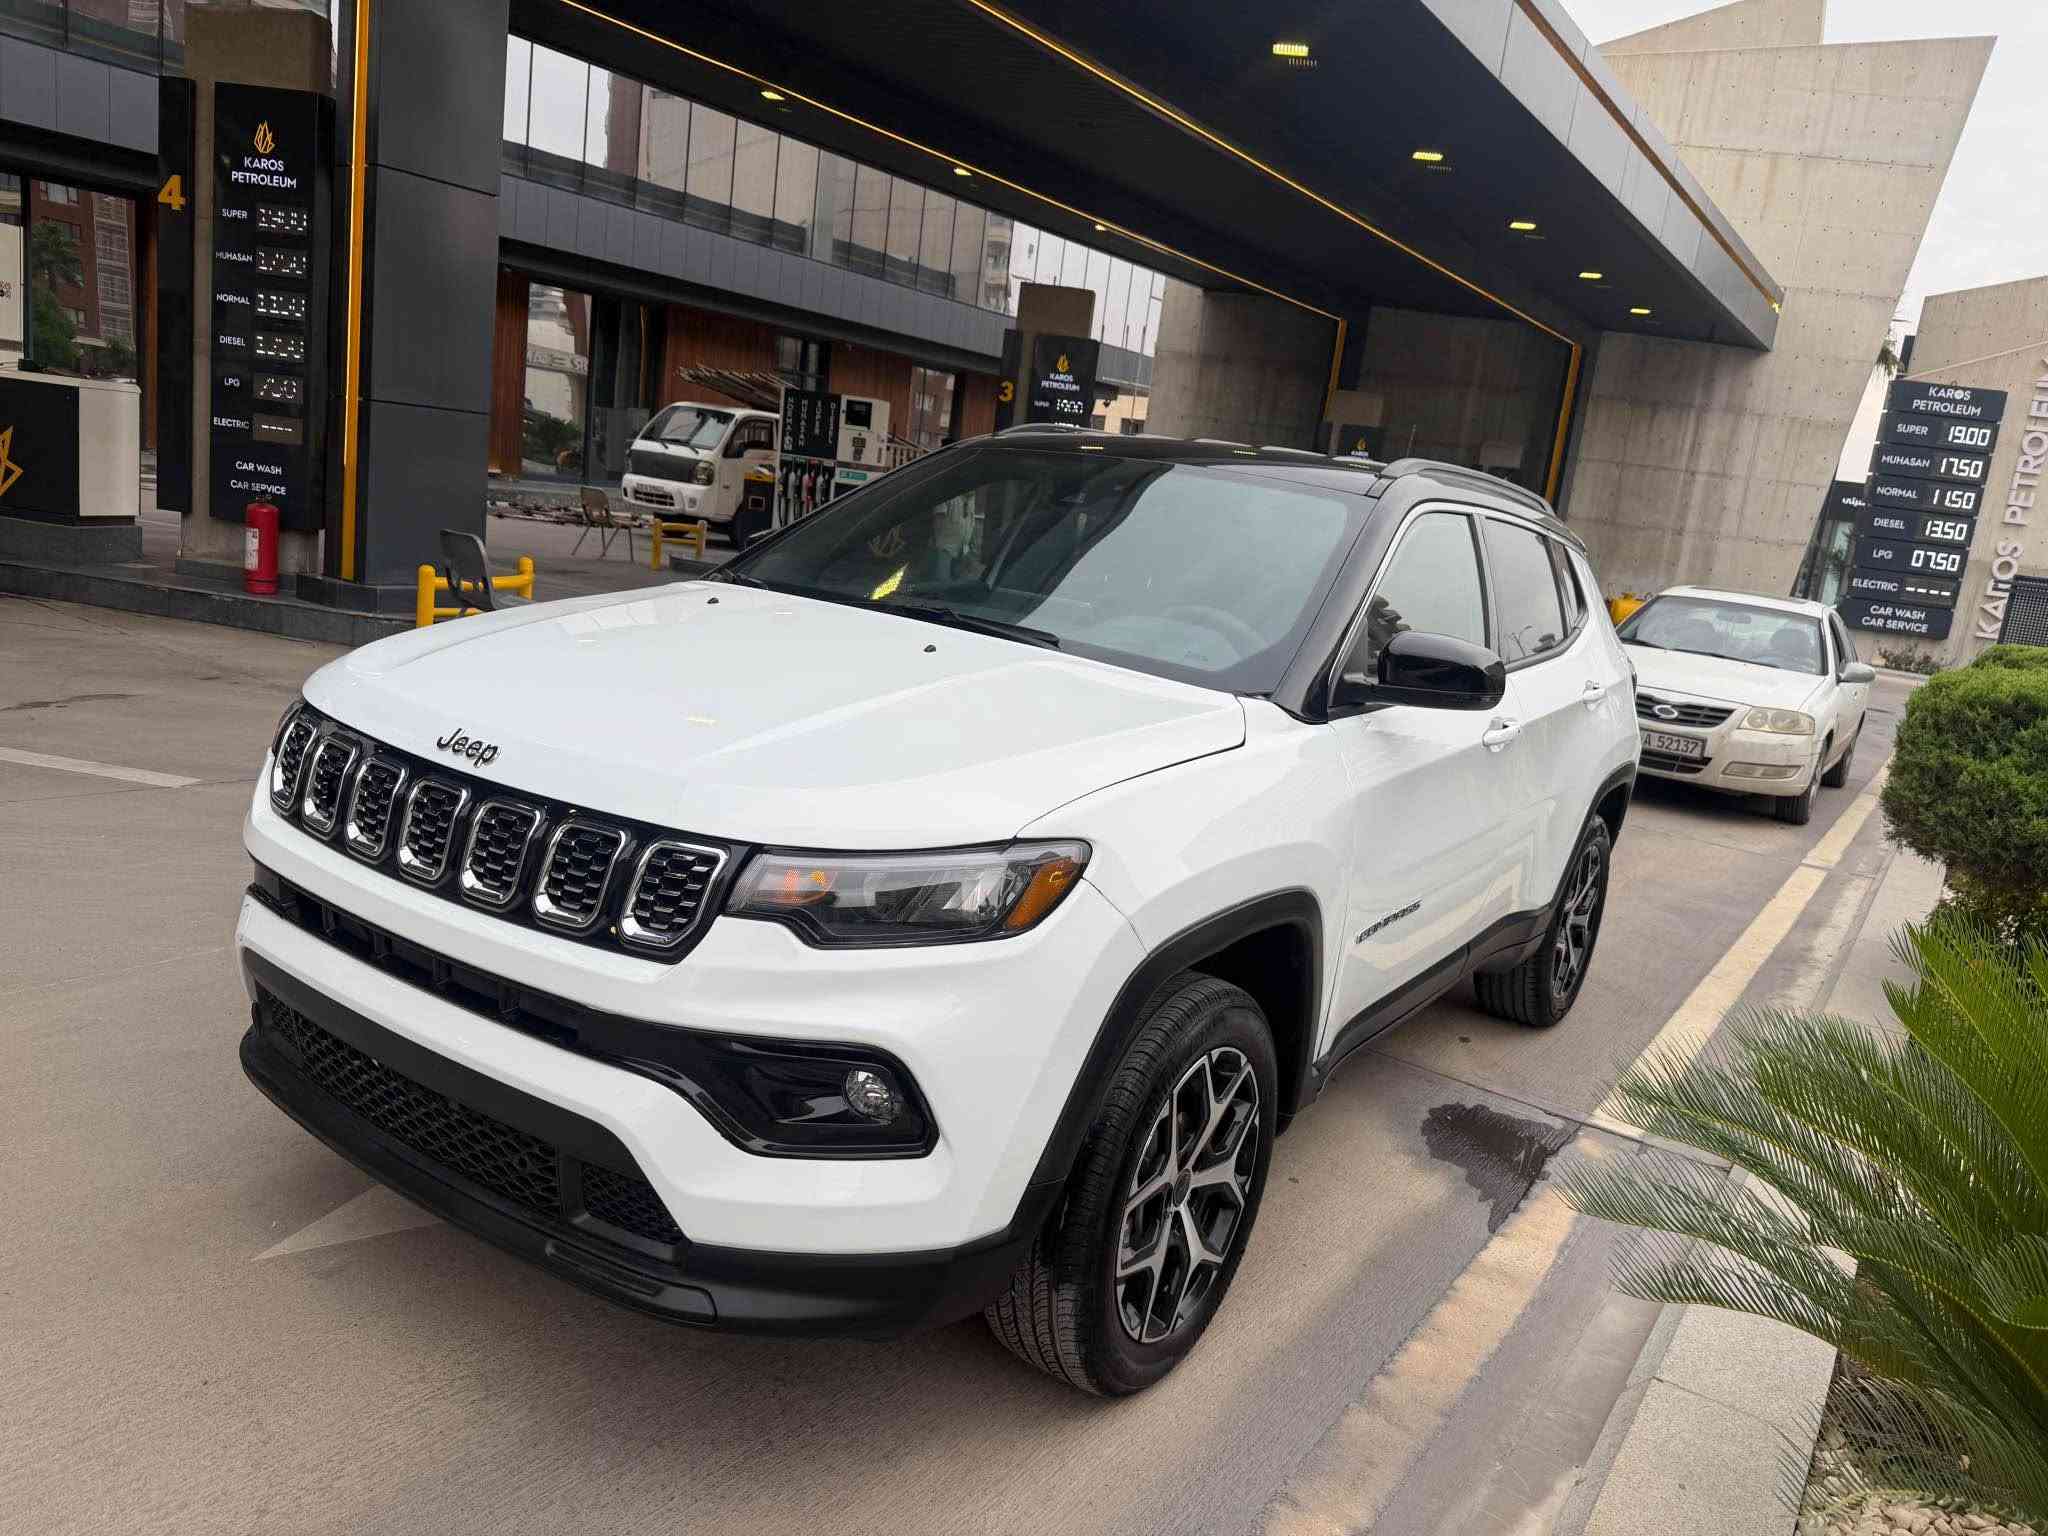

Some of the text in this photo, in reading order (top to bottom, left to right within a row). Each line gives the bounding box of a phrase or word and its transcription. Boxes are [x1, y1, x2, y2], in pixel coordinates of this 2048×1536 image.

[244, 156, 284, 171] KAROS
[231, 171, 297, 189] PETROLEUM
[158, 175, 186, 210] 4
[221, 208, 248, 219] SUPER
[216, 251, 253, 263] MUHASAN
[216, 293, 250, 305] NORMAL
[219, 335, 246, 346] DIESEL
[224, 377, 240, 387] LPG
[1049, 373, 1074, 382] KAROS
[999, 380, 1014, 401] 3
[1041, 380, 1080, 392] PETROLEUM
[1928, 386, 1972, 401] KAROS
[1912, 399, 1982, 416] PETROLEUM
[213, 417, 249, 430] ELECTRIC
[1896, 423, 1929, 435] SUPER
[2000, 357, 2048, 527] PETROLEU
[235, 461, 283, 476] CAR WASH
[1881, 455, 1930, 468] MUHASAN
[230, 480, 287, 496] CAR SERVICE
[1876, 486, 1918, 499] NORMAL
[1873, 517, 1905, 530] DIESEL
[1872, 549, 1893, 560] LPG
[1852, 577, 1899, 592] ELECTRIC
[1870, 604, 1926, 621] CAR WASH
[1861, 616, 1929, 633] CAR SERVICE
[436, 728, 498, 767] Jeep
[1656, 735, 1699, 753] 52137
